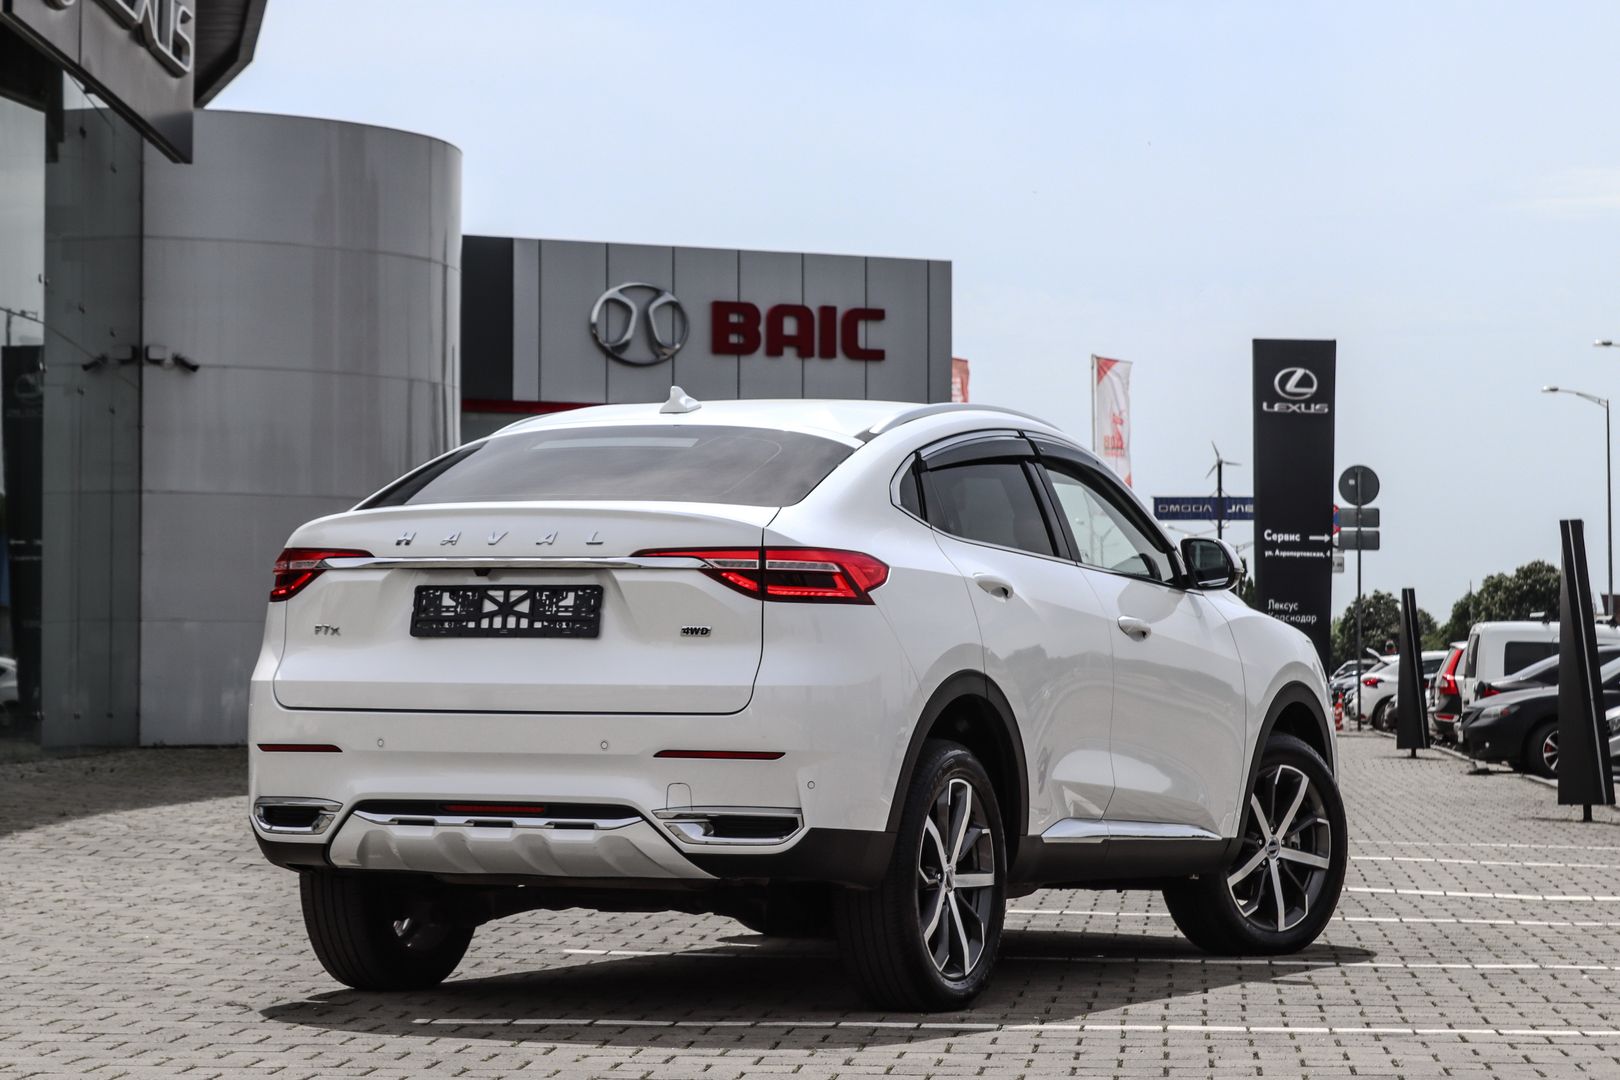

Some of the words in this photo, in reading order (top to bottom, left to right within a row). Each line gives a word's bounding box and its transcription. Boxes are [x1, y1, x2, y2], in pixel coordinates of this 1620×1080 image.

[711, 300, 886, 361] BAIC
[1262, 401, 1329, 413] LEXUS
[1158, 504, 1212, 513] OMODA
[395, 531, 604, 546] HAVAL
[1263, 528, 1301, 543] Сервис
[1268, 598, 1299, 612] Лексус
[681, 626, 711, 636] 4WD
